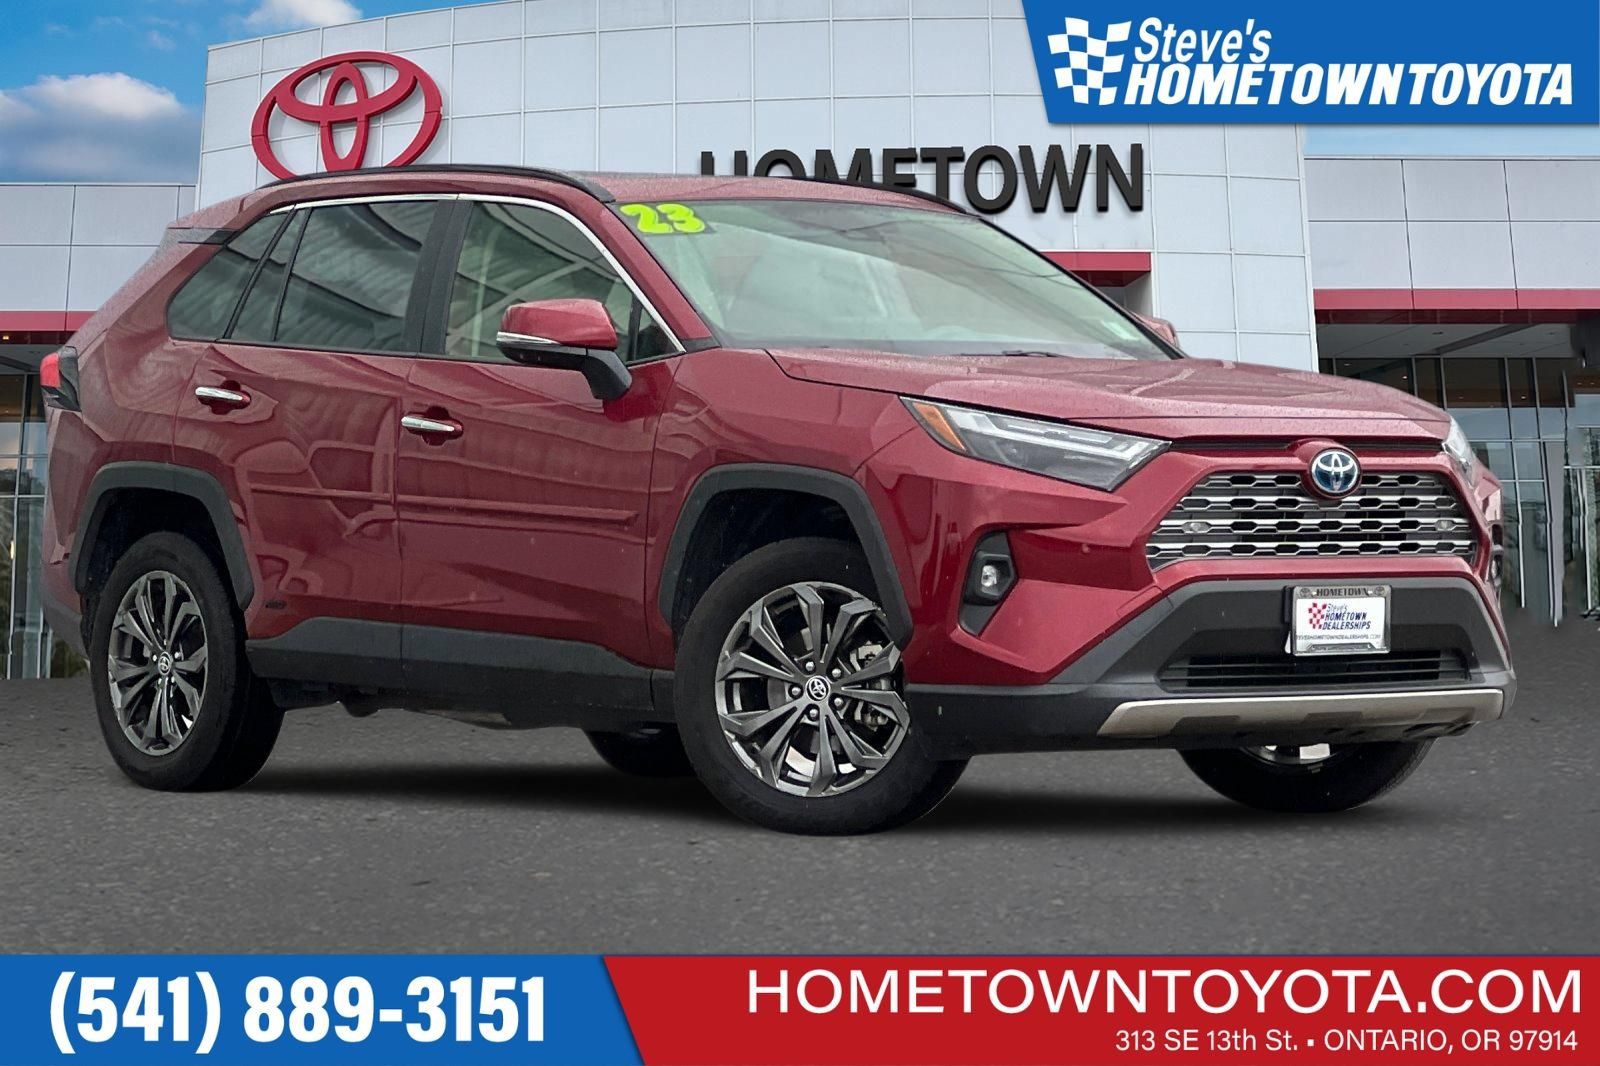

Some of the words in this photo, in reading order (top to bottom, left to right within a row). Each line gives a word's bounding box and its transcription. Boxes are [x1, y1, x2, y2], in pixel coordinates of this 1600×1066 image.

[620, 203, 705, 233] 23
[1316, 587, 1369, 597] HOMETOWN
[1326, 603, 1348, 612] Steve's
[1324, 612, 1367, 621] HOMETOWN
[1322, 621, 1371, 630] DEALERSHIPS
